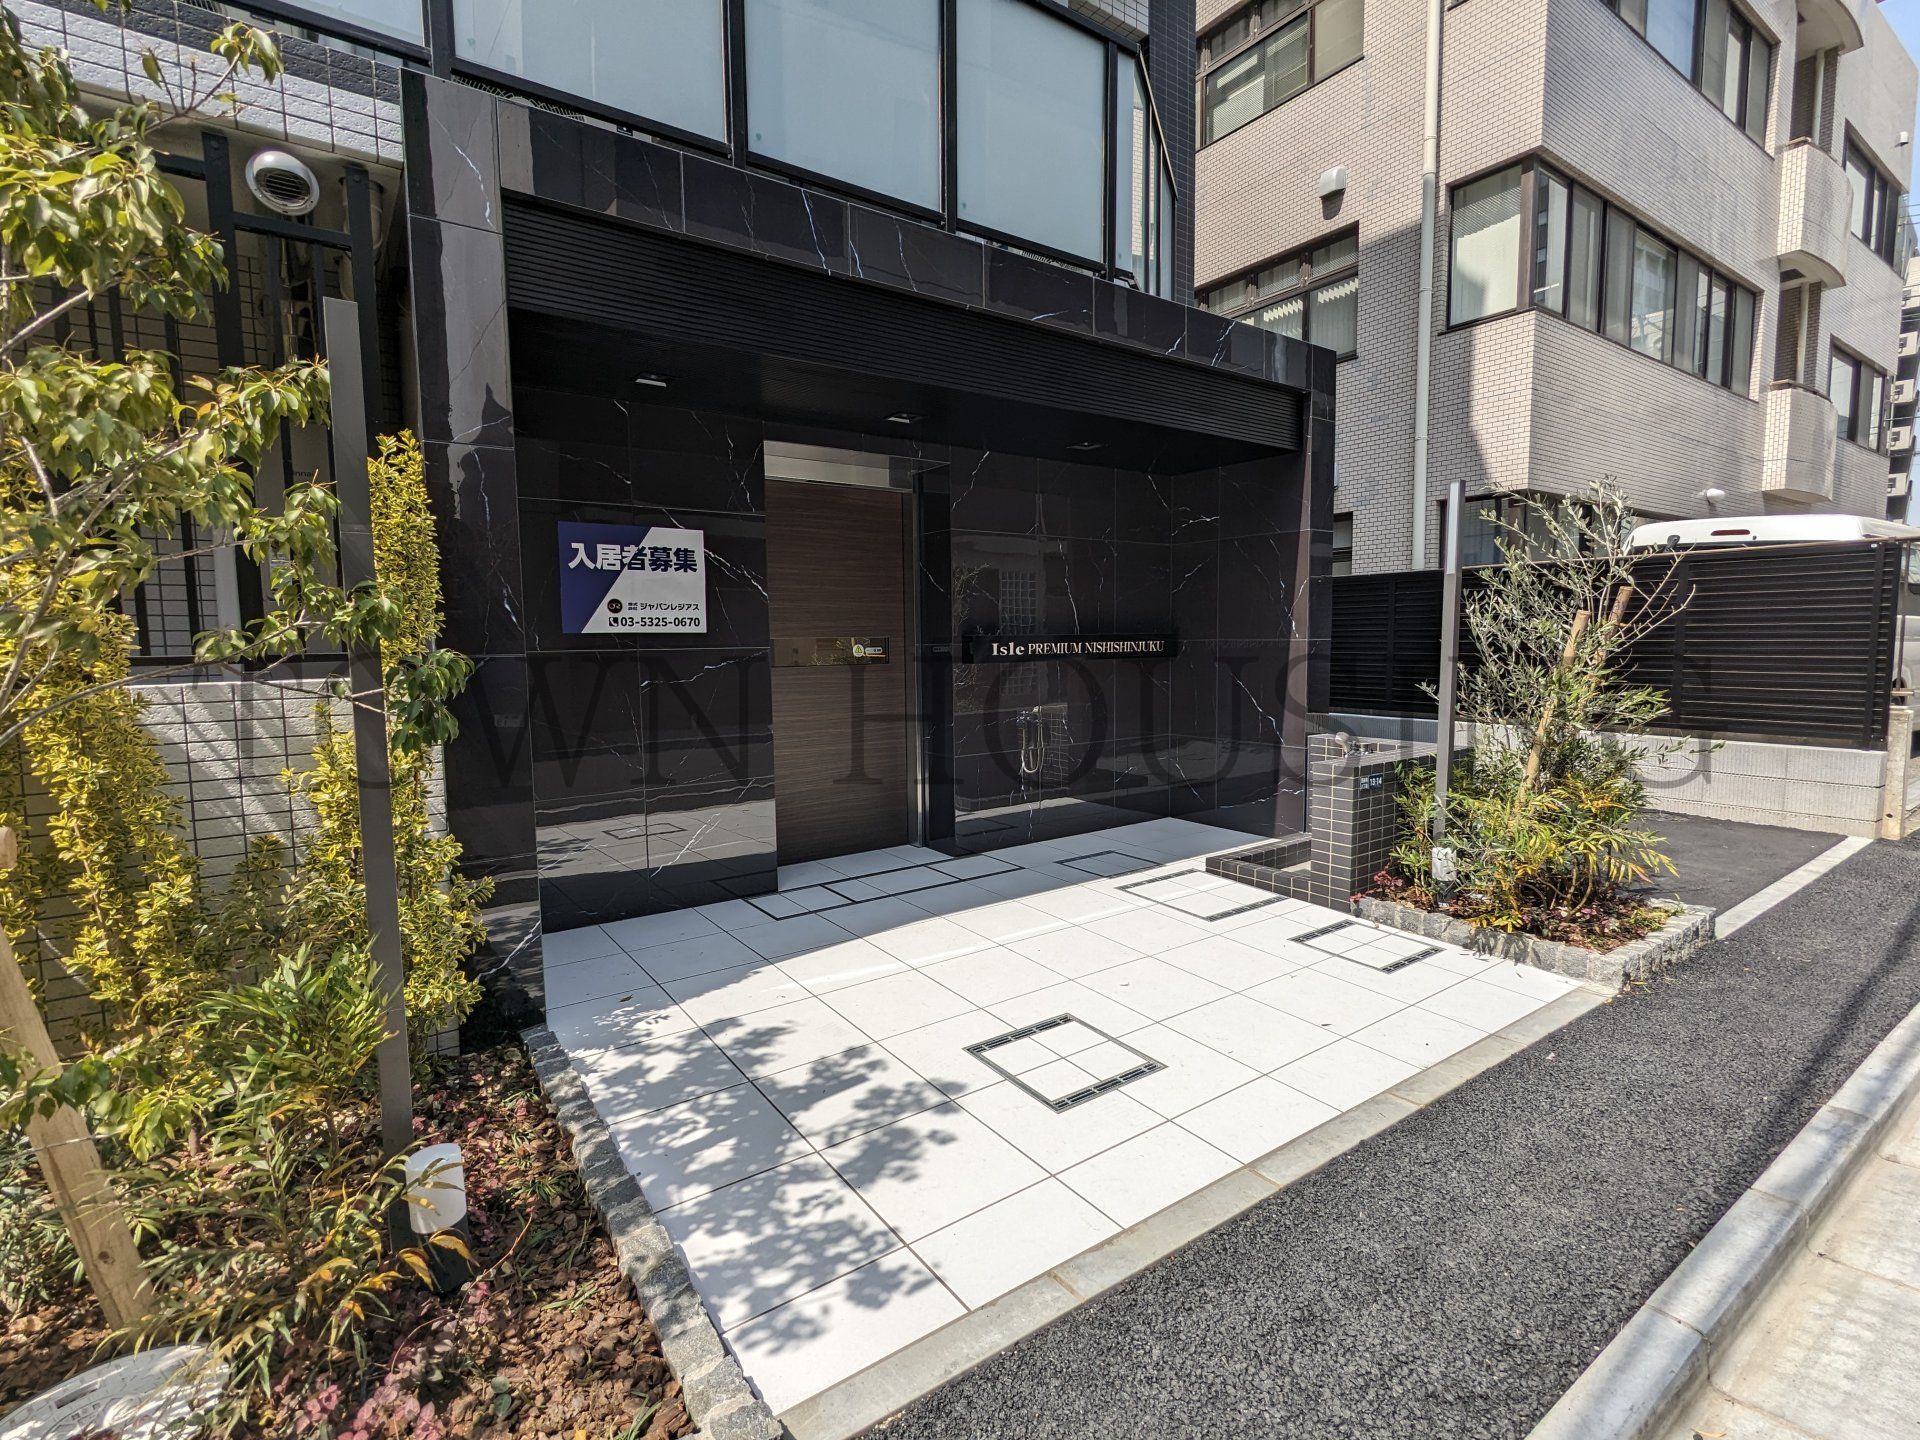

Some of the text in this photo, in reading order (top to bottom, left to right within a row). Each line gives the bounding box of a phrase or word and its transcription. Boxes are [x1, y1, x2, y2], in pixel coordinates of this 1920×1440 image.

[568, 542, 698, 573] 入居者募集
[640, 602, 700, 611] ジャパンレジアス
[620, 616, 701, 627] 03-5325-0670
[991, 640, 1165, 656] Isle PREMIUM NISHISHINJUKU
